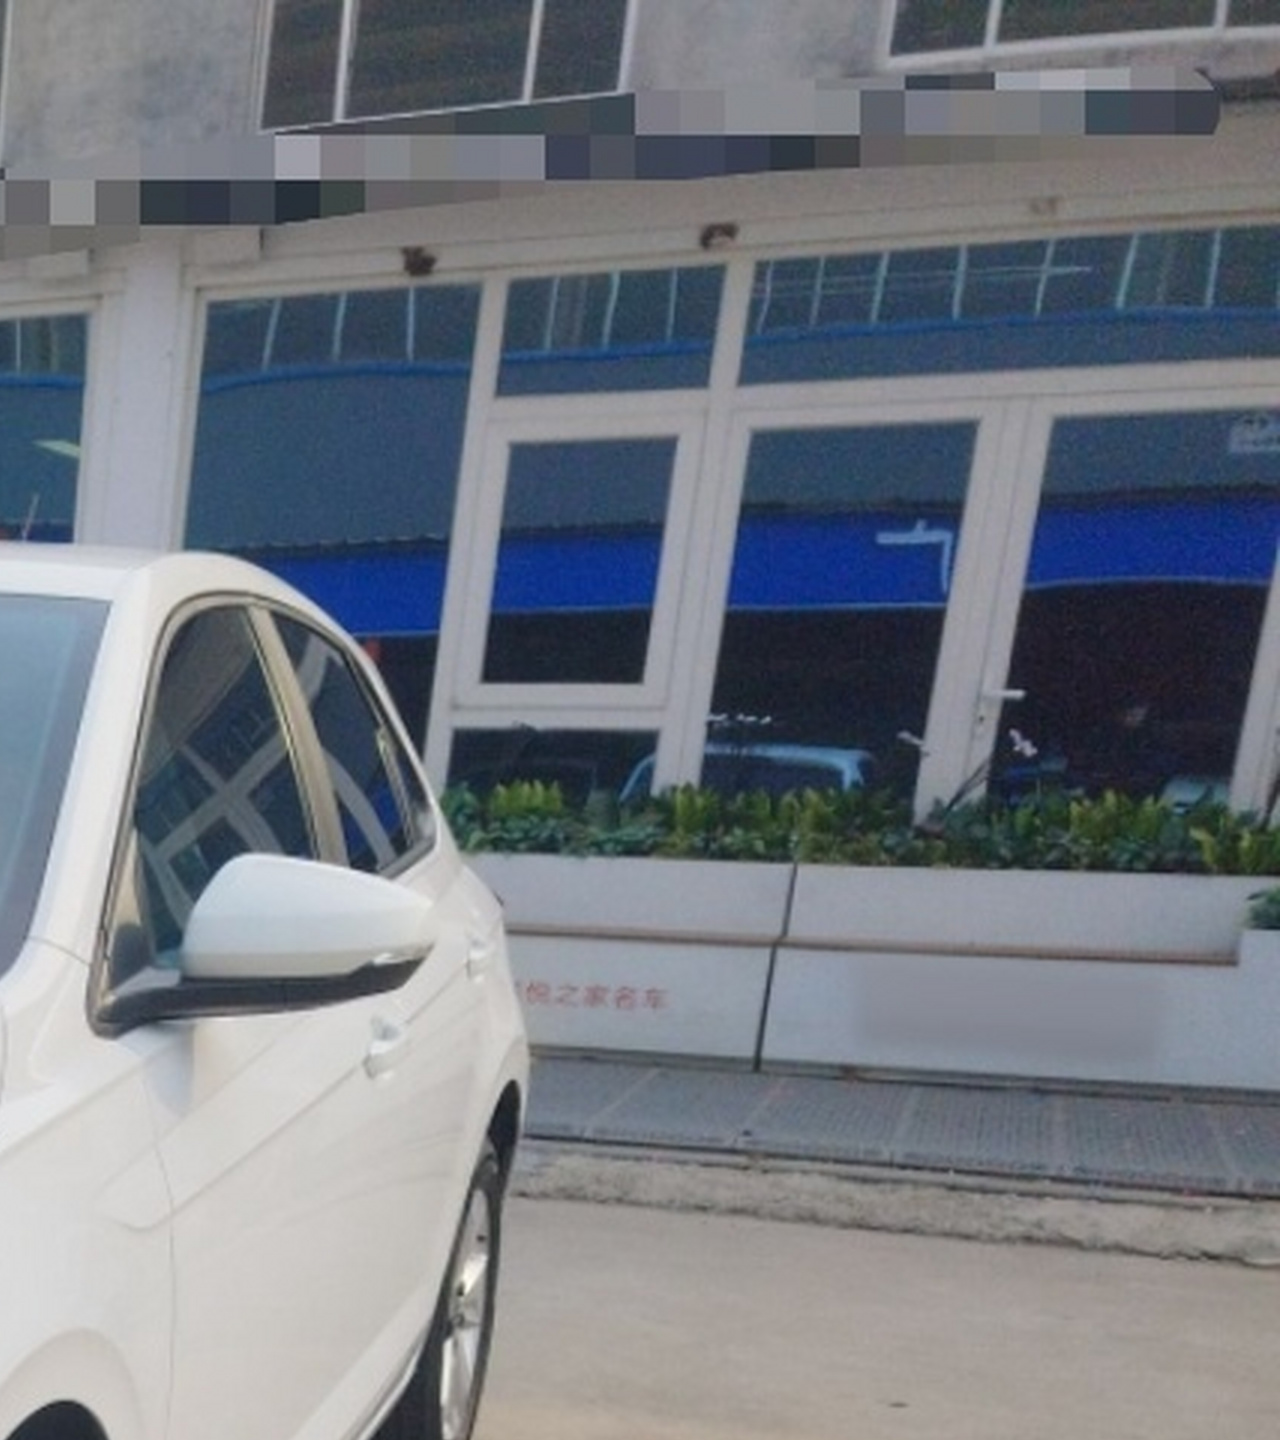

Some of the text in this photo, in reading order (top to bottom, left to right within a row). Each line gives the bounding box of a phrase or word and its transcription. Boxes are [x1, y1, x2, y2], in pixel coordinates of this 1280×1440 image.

[514, 978, 669, 1012] 悦之家名车
